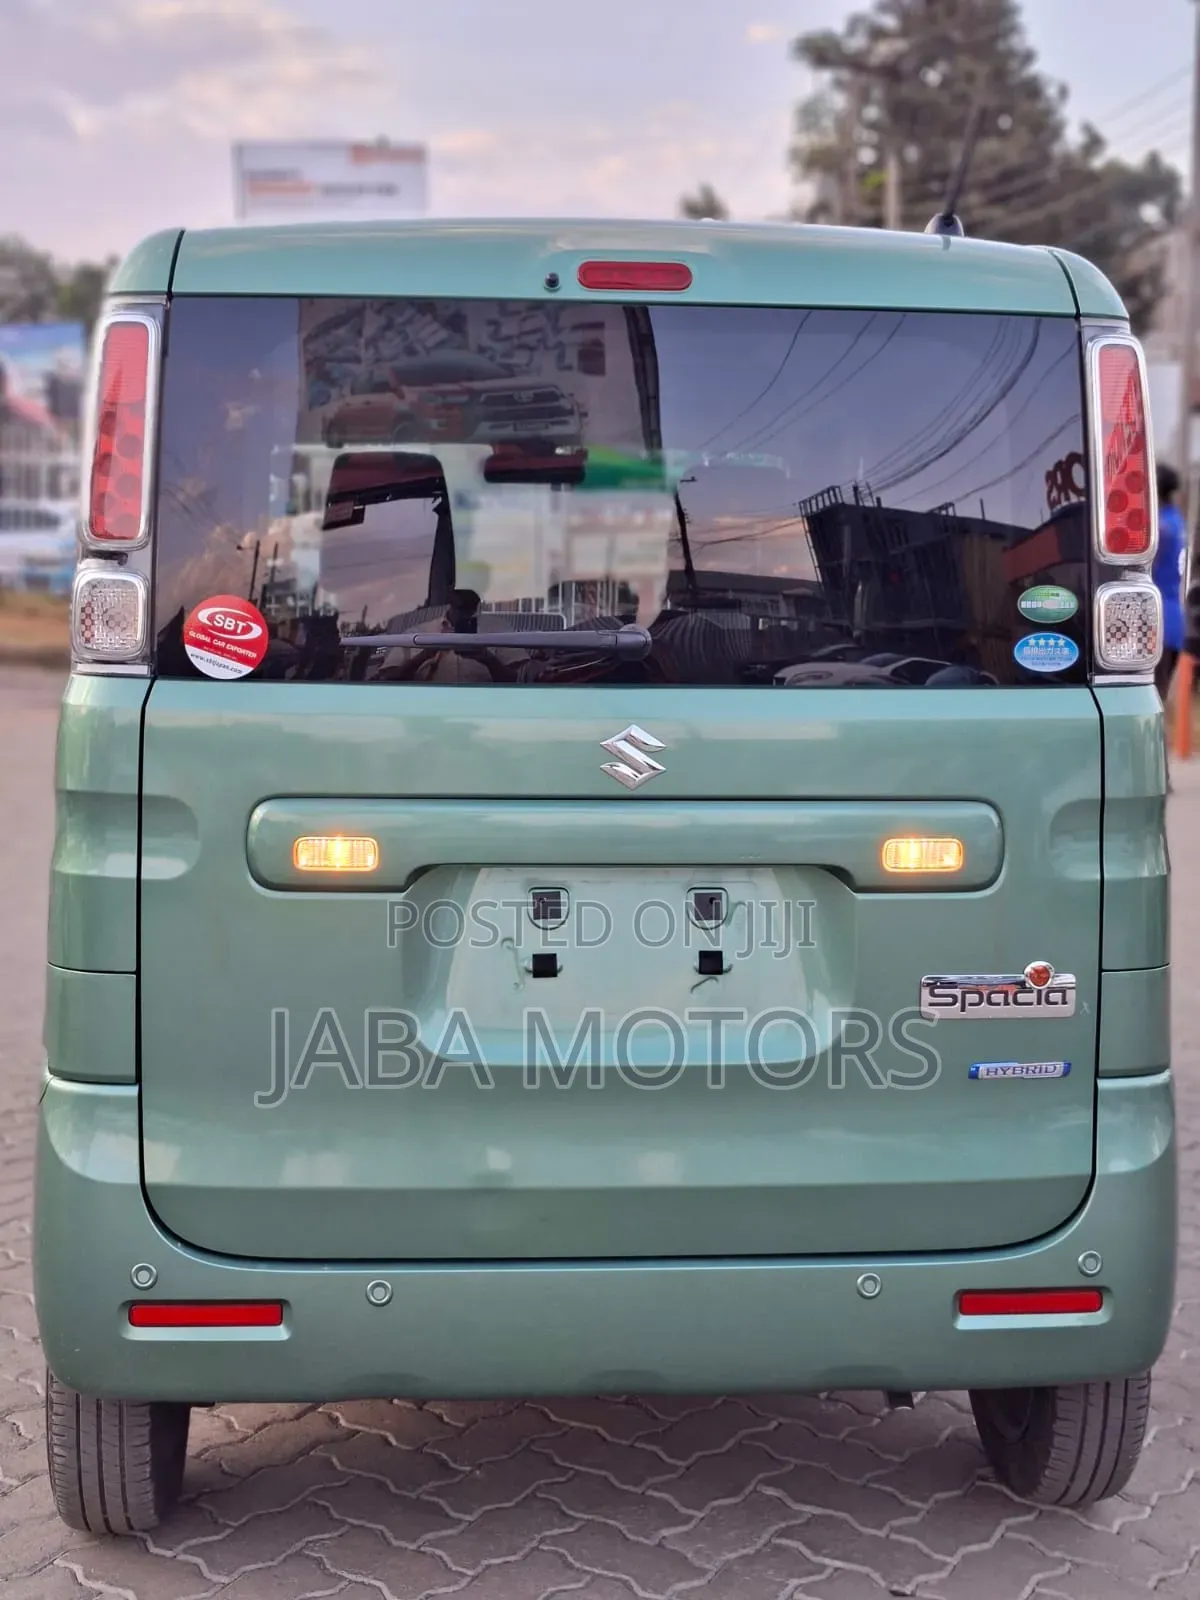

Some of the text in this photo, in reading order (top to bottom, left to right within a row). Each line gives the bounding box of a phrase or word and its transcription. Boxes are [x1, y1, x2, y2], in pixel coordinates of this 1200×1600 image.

[213, 614, 247, 634] SBT
[189, 631, 211, 643] GLOBAL
[212, 638, 226, 649] CAR
[226, 643, 257, 658] EXPORTER
[928, 984, 1068, 1013] Spacia
[985, 1064, 1058, 1077] HYBRID
